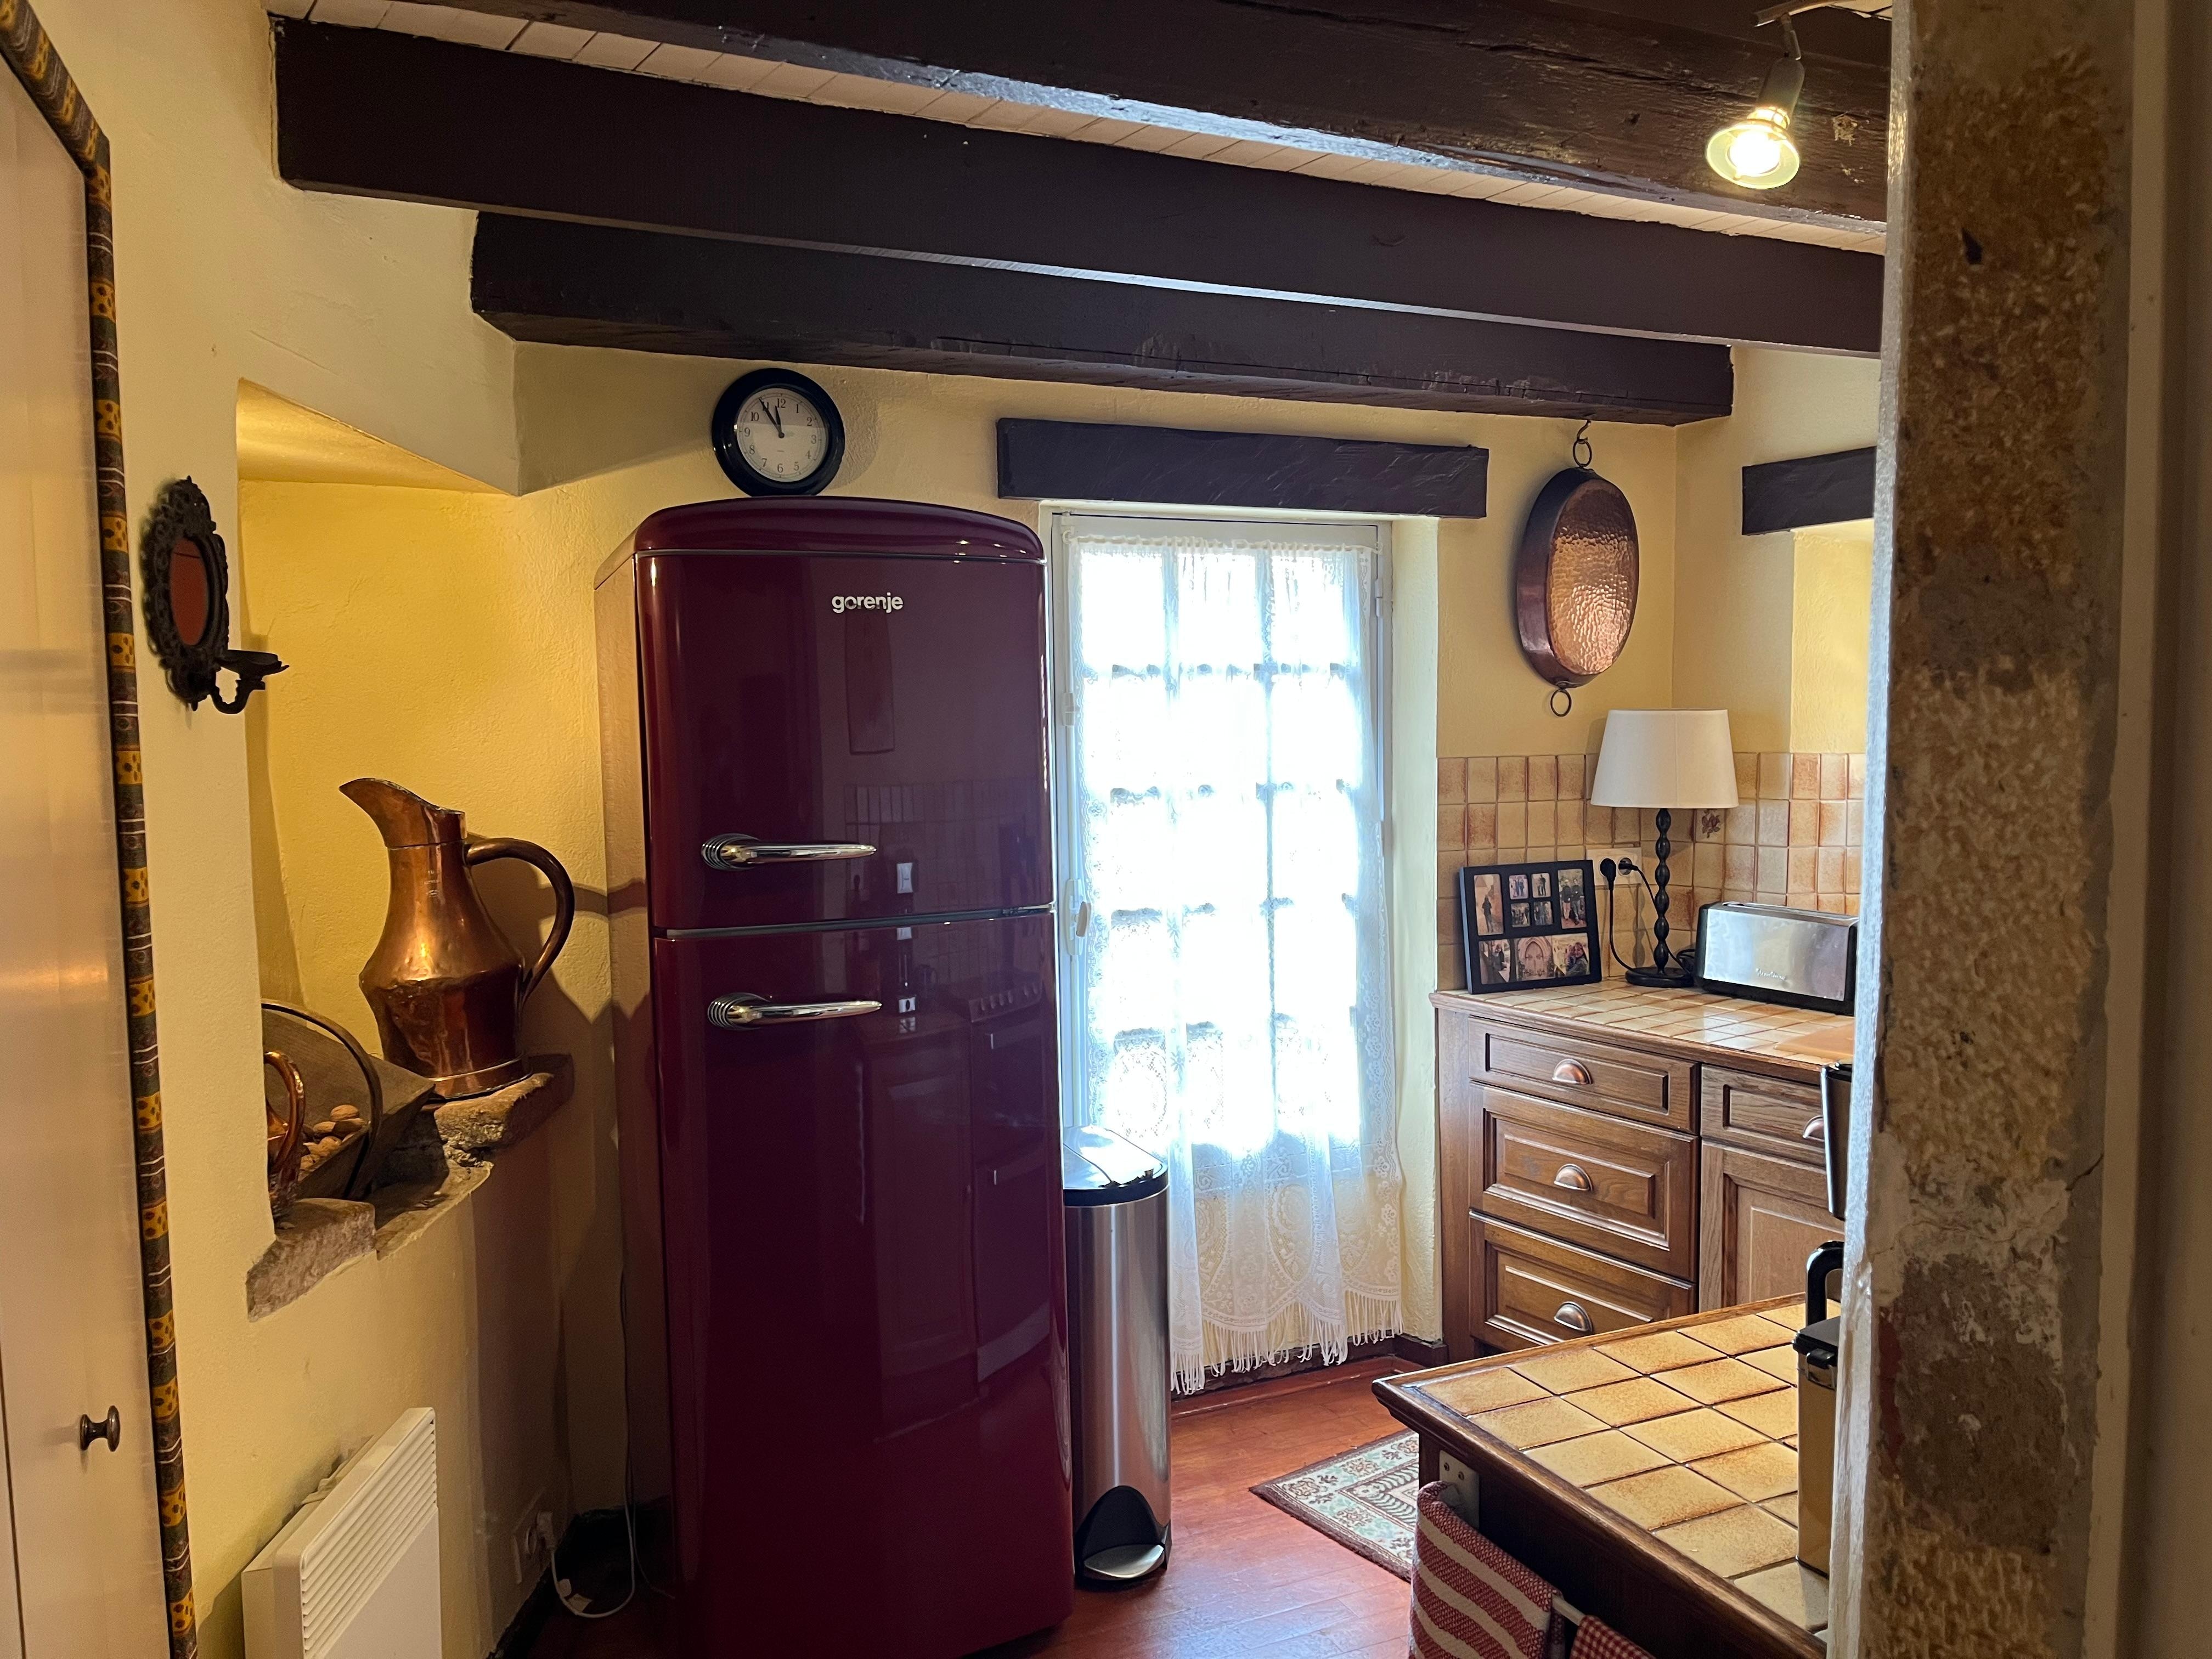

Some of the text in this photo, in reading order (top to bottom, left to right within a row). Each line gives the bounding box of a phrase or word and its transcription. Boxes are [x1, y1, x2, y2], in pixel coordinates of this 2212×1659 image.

[777, 398, 786, 409] 12
[795, 403, 799, 414] 1
[750, 411, 759, 422] 10
[806, 416, 812, 427] 2
[744, 427, 751, 437] 9
[810, 434, 817, 444] 3
[749, 444, 755, 455] 8
[804, 450, 811, 460] 4
[761, 458, 768, 467] 7
[793, 461, 800, 471] 5
[777, 463, 784, 473] 6
[831, 592, 904, 614] gorenje
